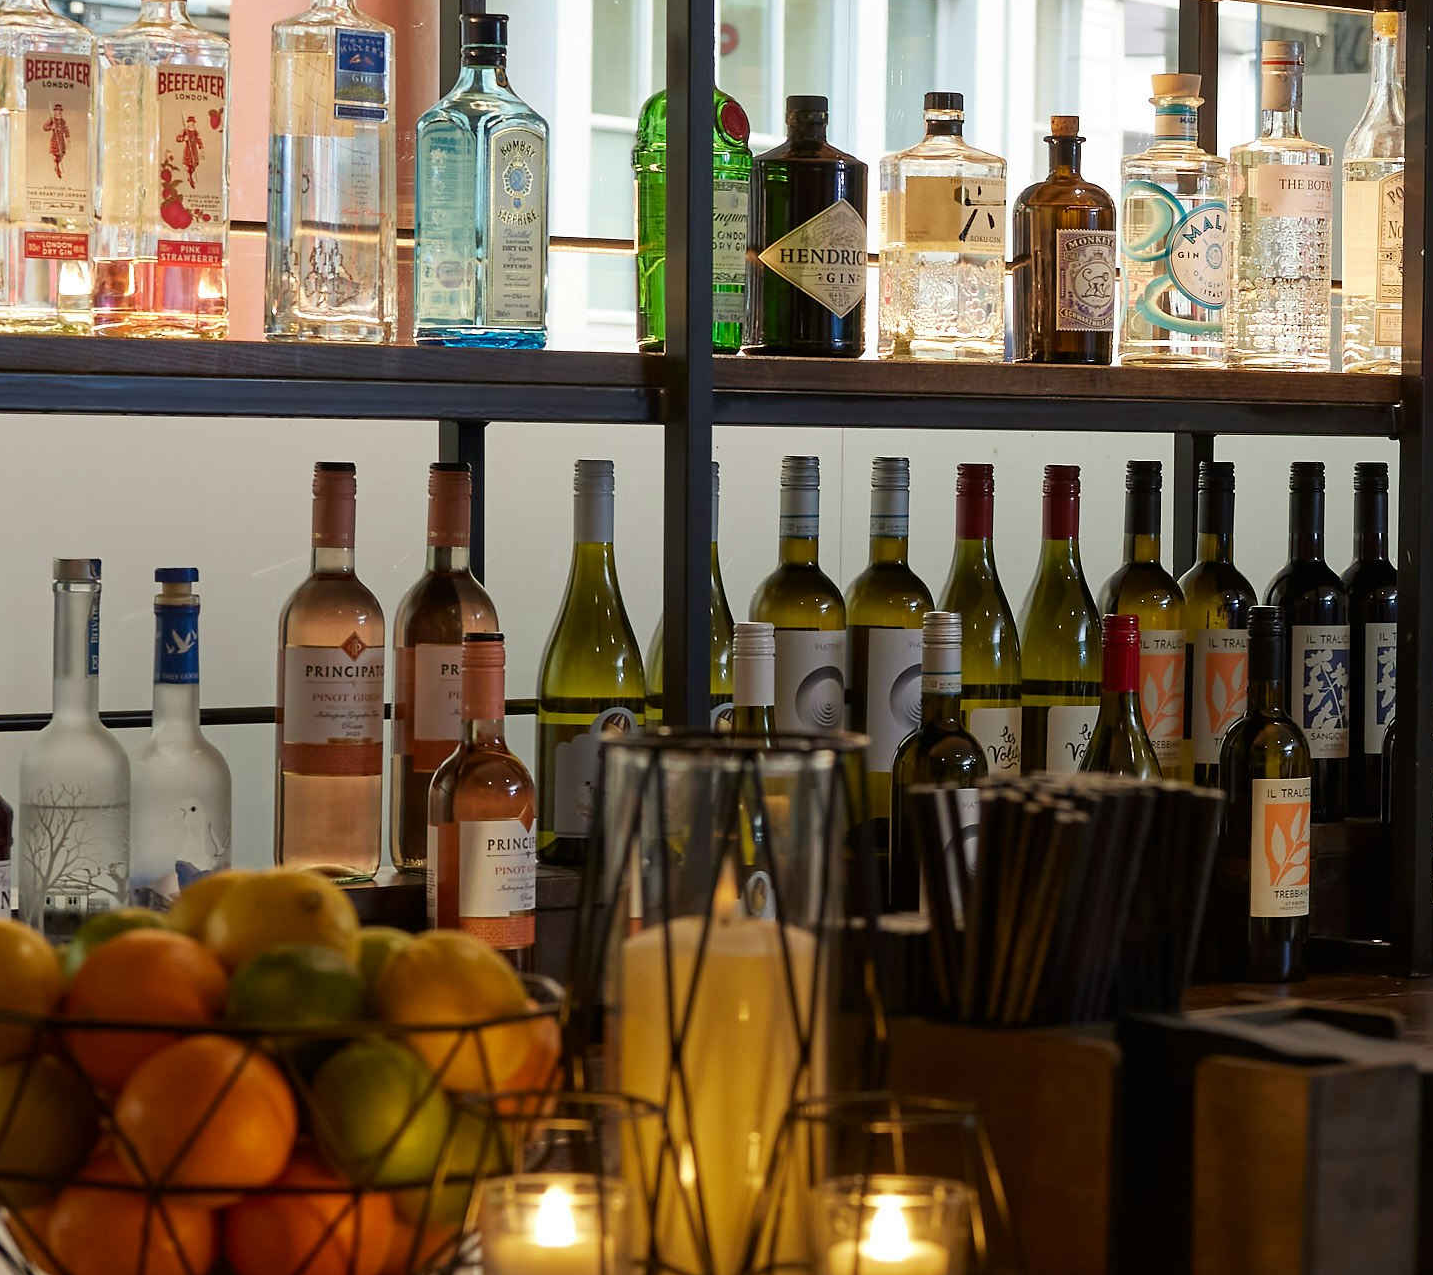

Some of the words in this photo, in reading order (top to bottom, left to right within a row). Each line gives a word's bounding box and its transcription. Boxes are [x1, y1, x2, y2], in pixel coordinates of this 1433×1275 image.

[26, 58, 91, 88] BEEFEATER
[42, 80, 74, 89] LONDON
[158, 72, 224, 100] BEEFEATER
[175, 93, 208, 101] LONDON
[499, 139, 537, 160] BOMBAY
[1279, 179, 1304, 190] THE
[497, 208, 538, 225] SAPPHIRE
[42, 241, 73, 249] LONDON
[180, 245, 200, 254] PINK
[160, 252, 219, 263] STRAWBERRY
[1177, 252, 1200, 260] GIN
[827, 274, 856, 284] GIN
[312, 693, 348, 702] PINOT
[1000, 724, 1016, 745] les
[1267, 789, 1276, 799] IL
[495, 867, 526, 875] PINOT
